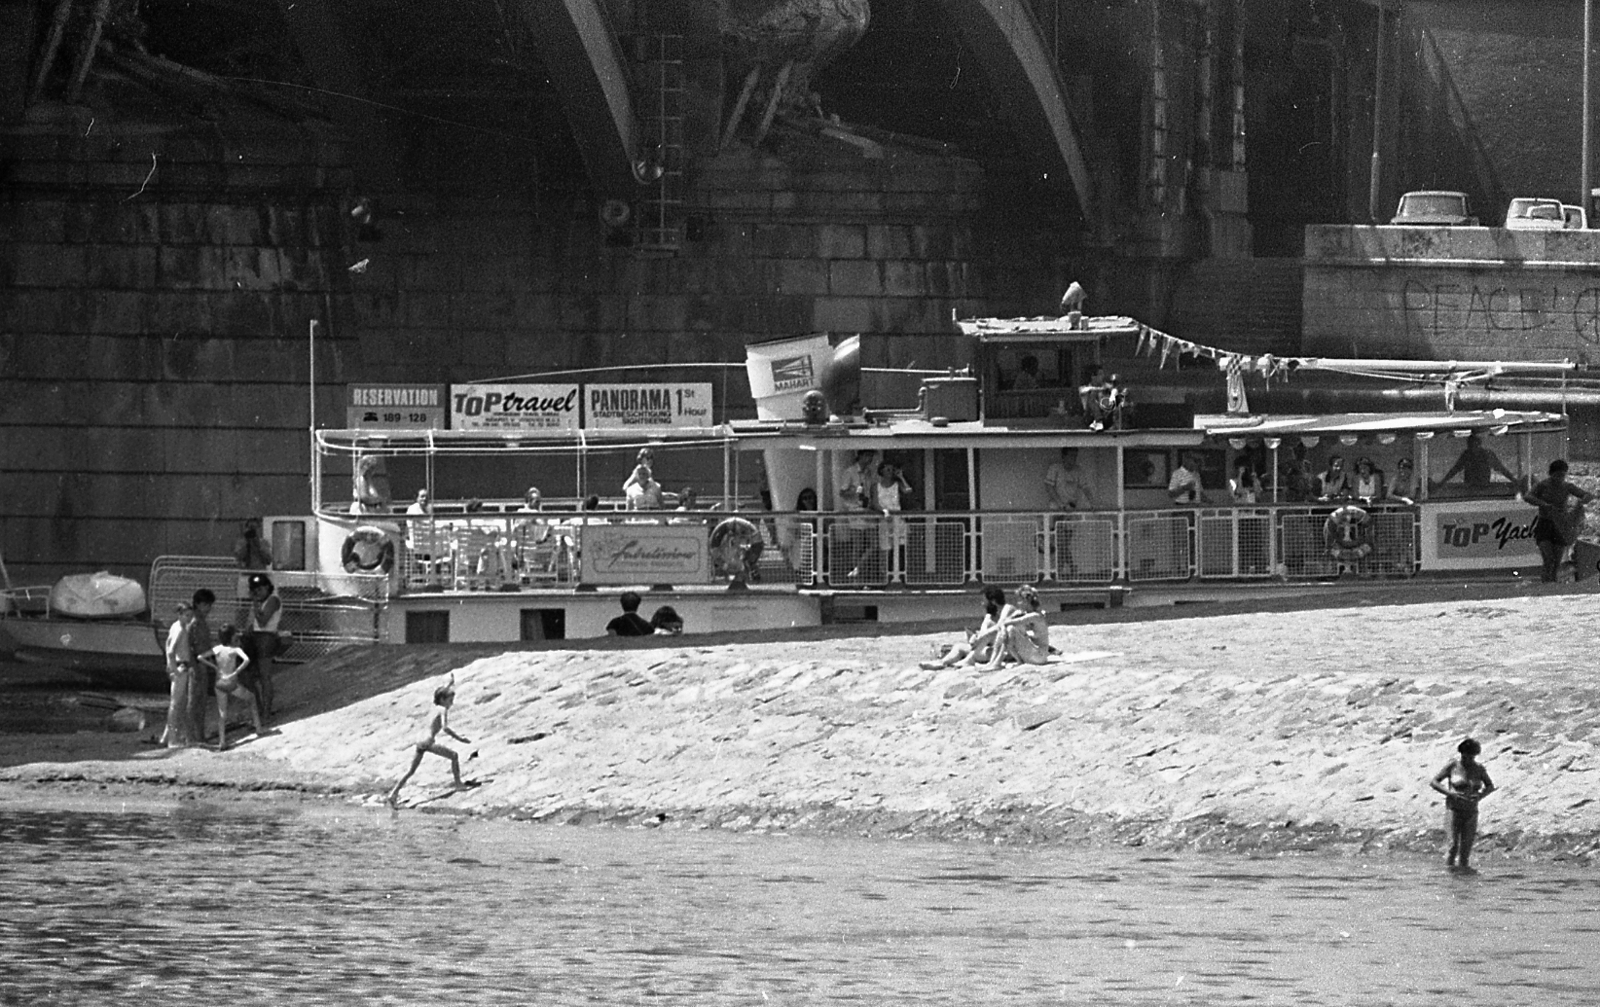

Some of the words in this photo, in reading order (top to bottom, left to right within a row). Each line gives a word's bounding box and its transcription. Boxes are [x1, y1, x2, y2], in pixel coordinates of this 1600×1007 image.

[353, 388, 438, 406] RESERVATION
[591, 388, 672, 411] PANORAMA
[684, 407, 707, 416] Hour
[1491, 515, 1539, 550] Yach
